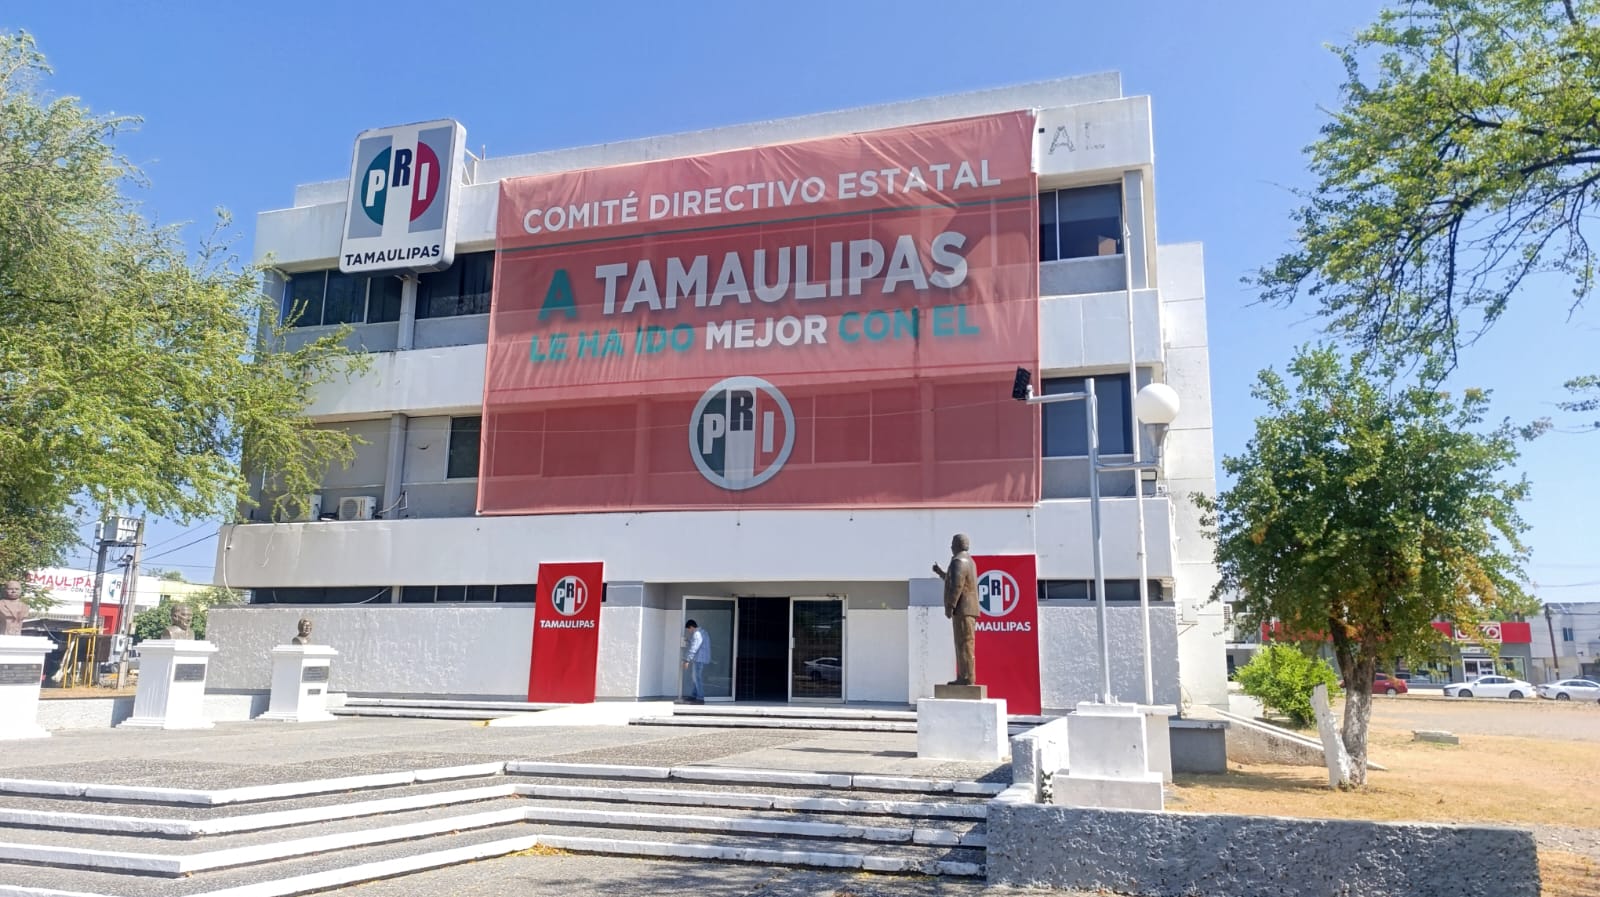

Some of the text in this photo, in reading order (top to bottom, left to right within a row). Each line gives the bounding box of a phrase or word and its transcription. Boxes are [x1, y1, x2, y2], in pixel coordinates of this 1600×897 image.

[365, 148, 431, 207] PRI
[523, 159, 1001, 234] COMITÉ DIRECTIVO ESTATAL
[345, 244, 441, 266] TAMAULIPAS
[537, 231, 968, 322] A TAMAULIPAS
[529, 303, 980, 363] LE HA IDO MEJOR CON EL
[702, 390, 775, 454] PRI
[555, 582, 582, 604] PRI
[978, 579, 1010, 602] PRI
[540, 620, 595, 629] TAMAULIPAS
[975, 621, 1031, 631] MAULIPAS
